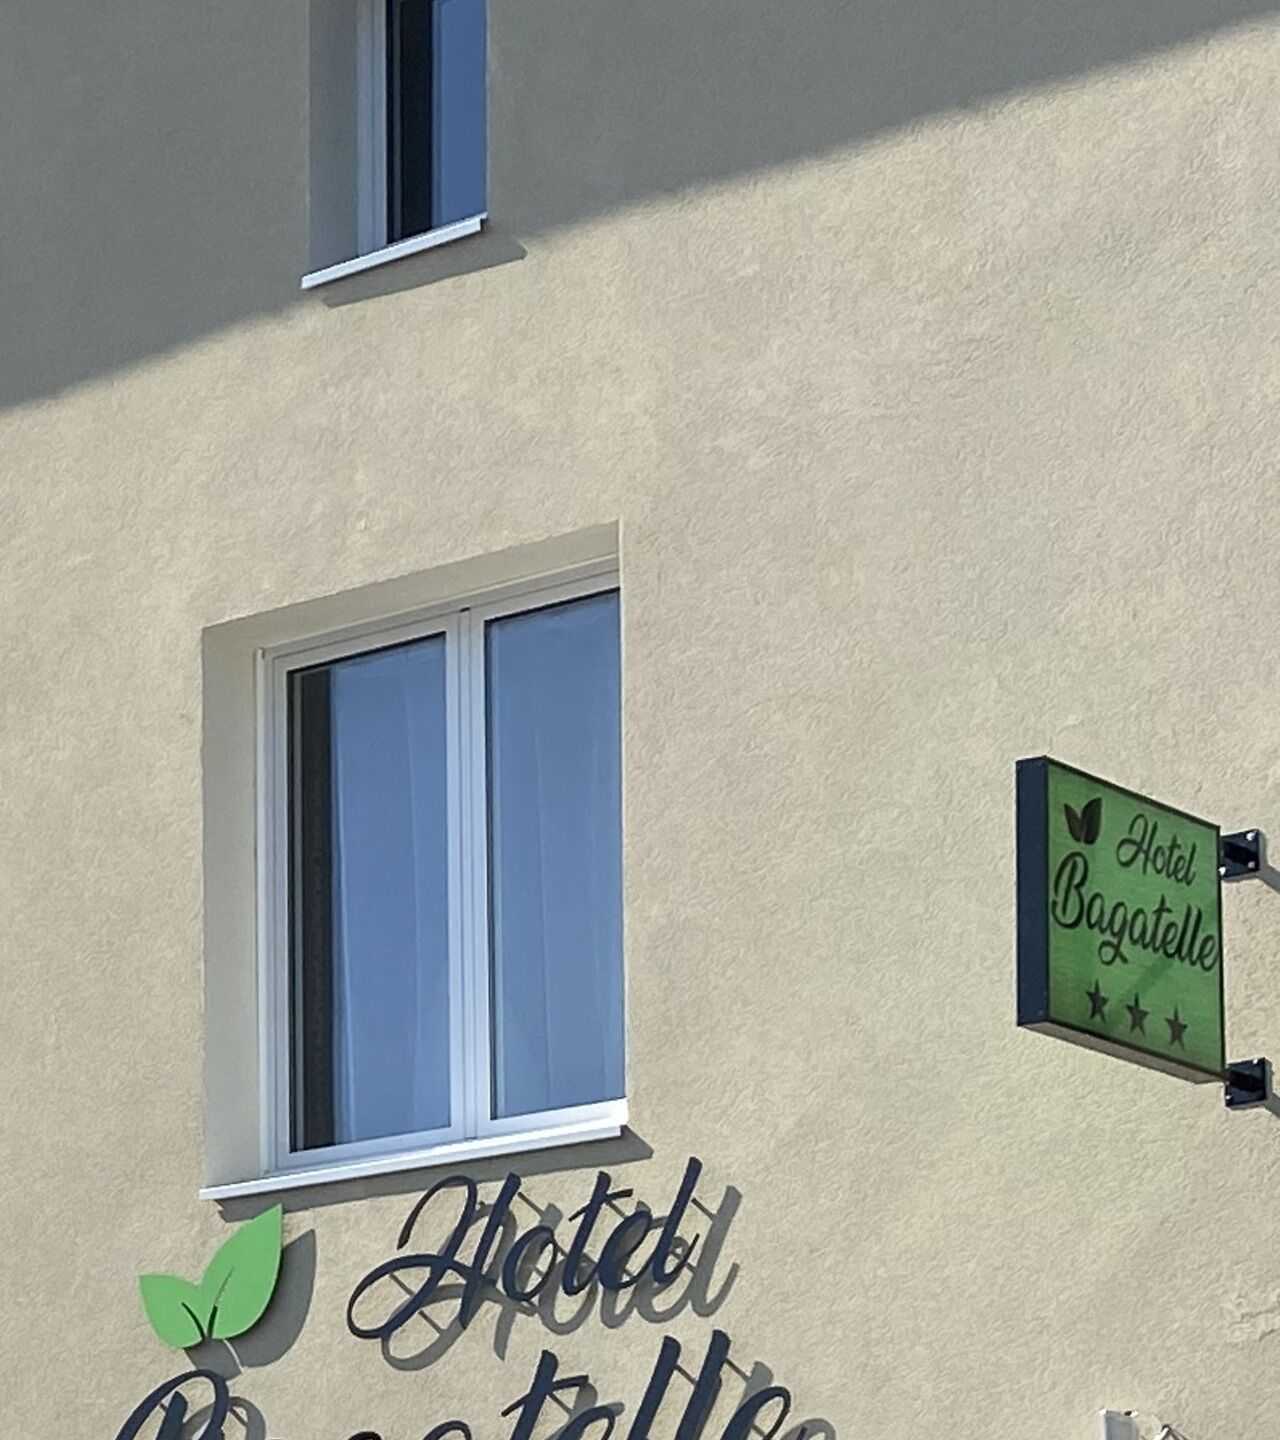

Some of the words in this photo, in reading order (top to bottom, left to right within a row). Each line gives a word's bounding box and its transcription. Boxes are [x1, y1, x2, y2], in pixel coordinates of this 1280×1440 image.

[1116, 813, 1197, 886] Hotel
[1051, 852, 1218, 972] Bagatelle
[347, 1156, 702, 1339] Hotel
